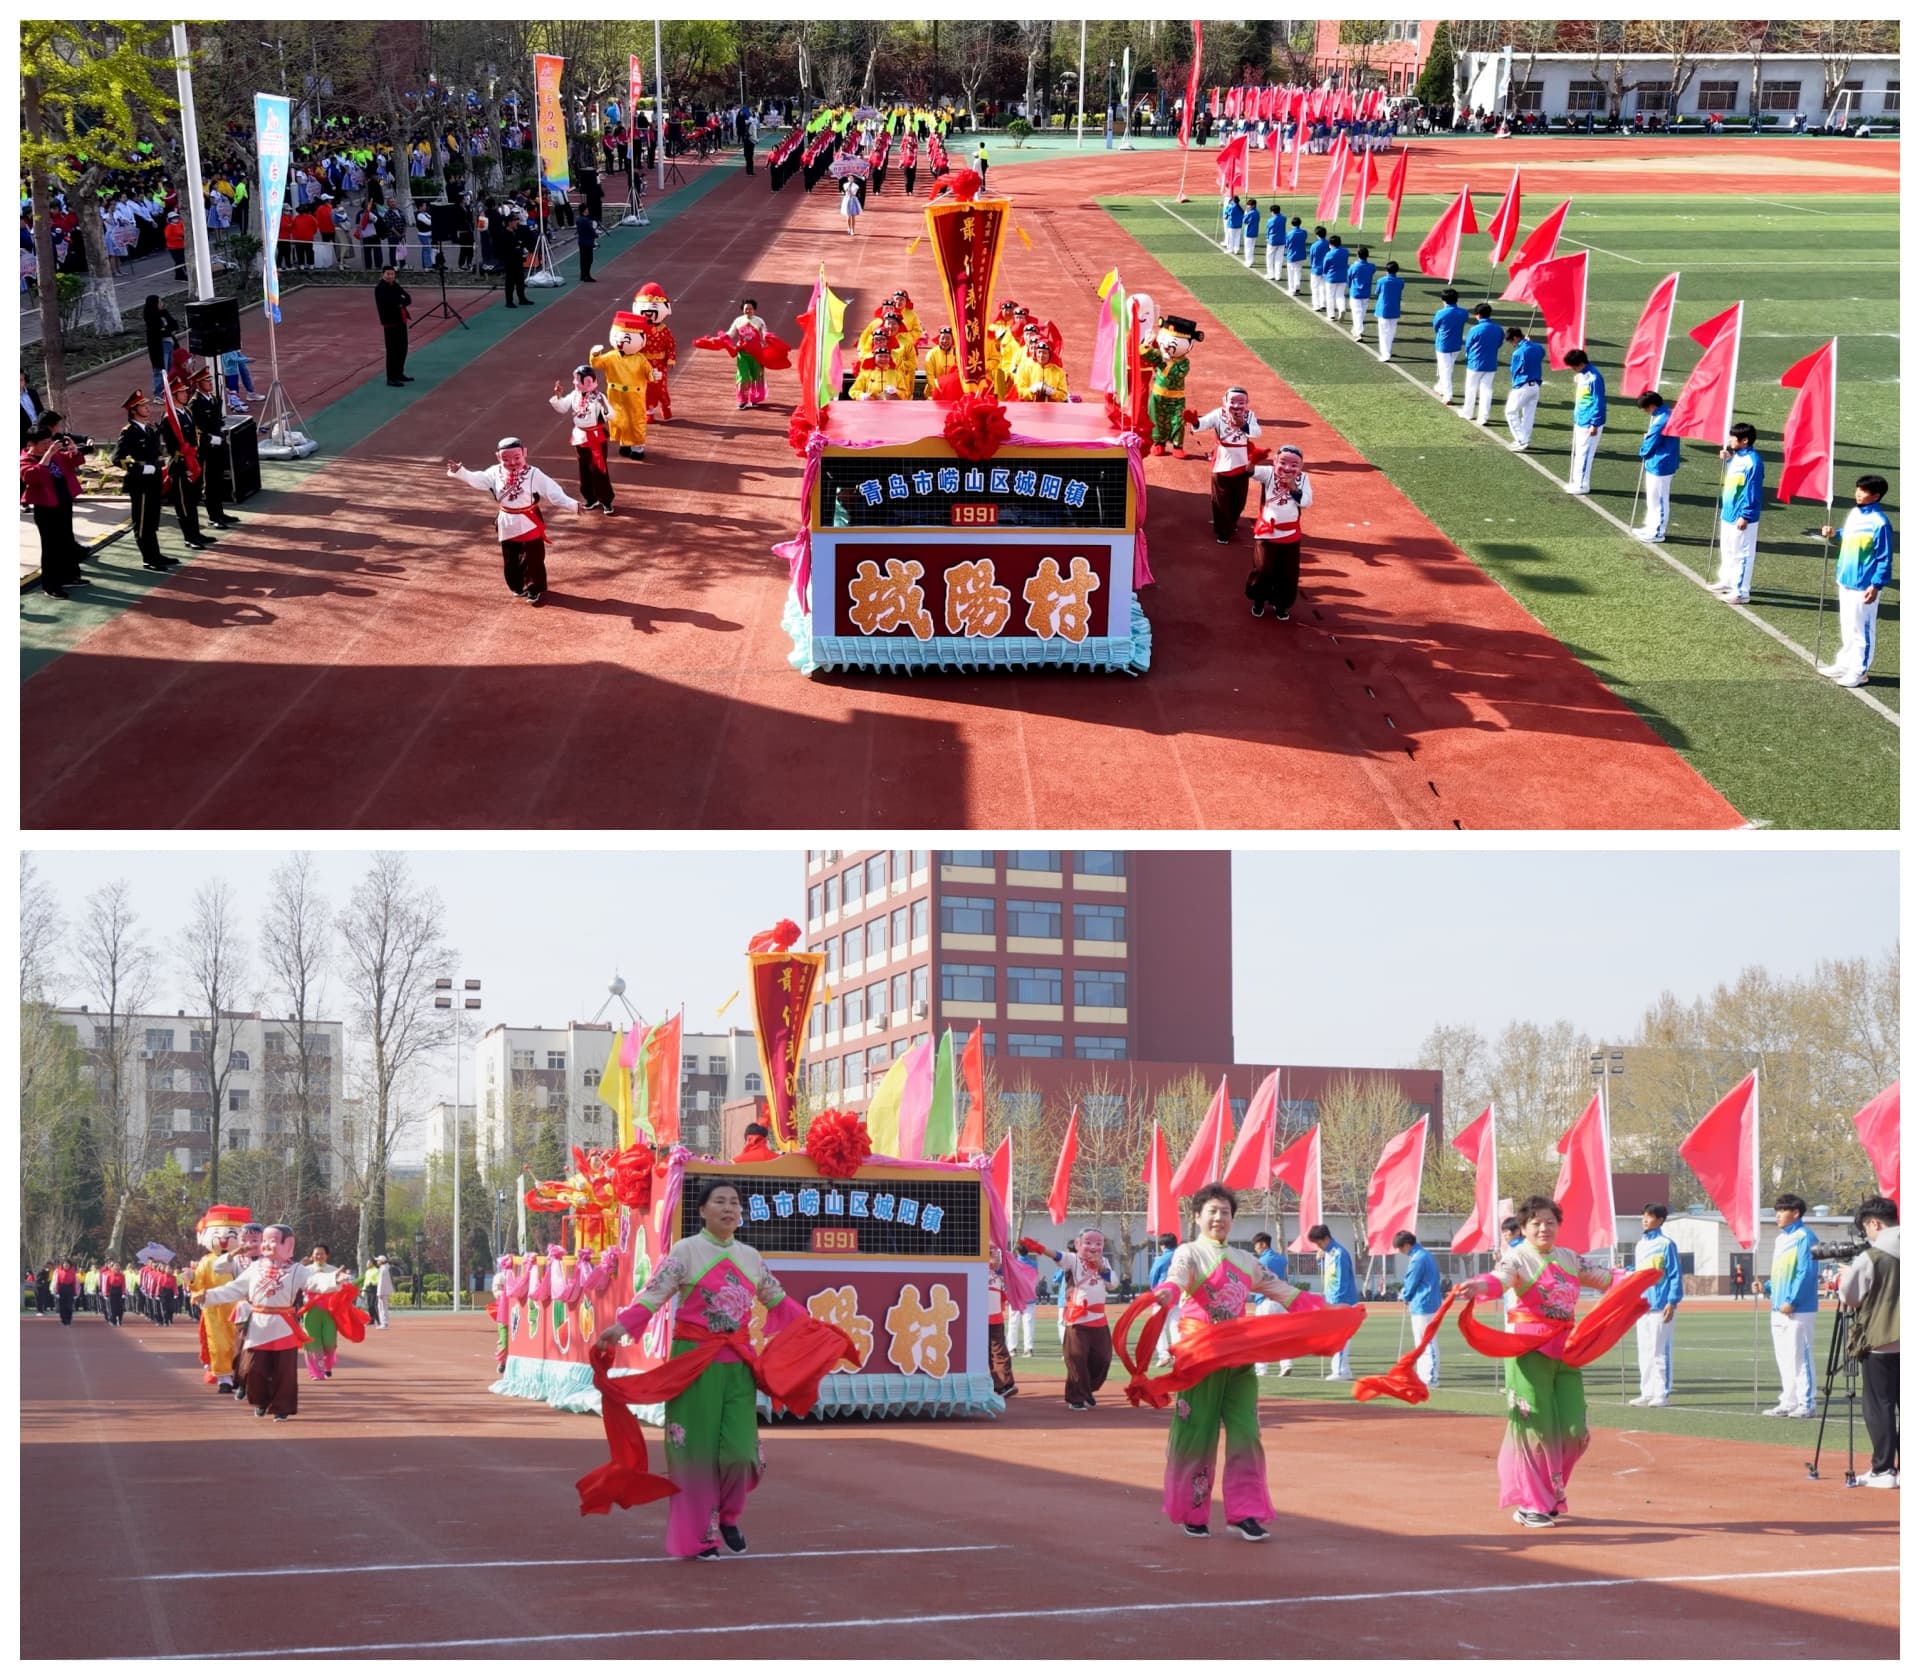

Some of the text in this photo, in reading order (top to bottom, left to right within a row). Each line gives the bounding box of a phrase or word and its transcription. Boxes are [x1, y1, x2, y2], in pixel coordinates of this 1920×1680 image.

[860, 468, 1088, 507] 青岛市崂山区城阳镇
[954, 507, 996, 523] 1991
[737, 1188, 944, 1234] 岛市崂山区城阳镇
[815, 1231, 856, 1249] 1991
